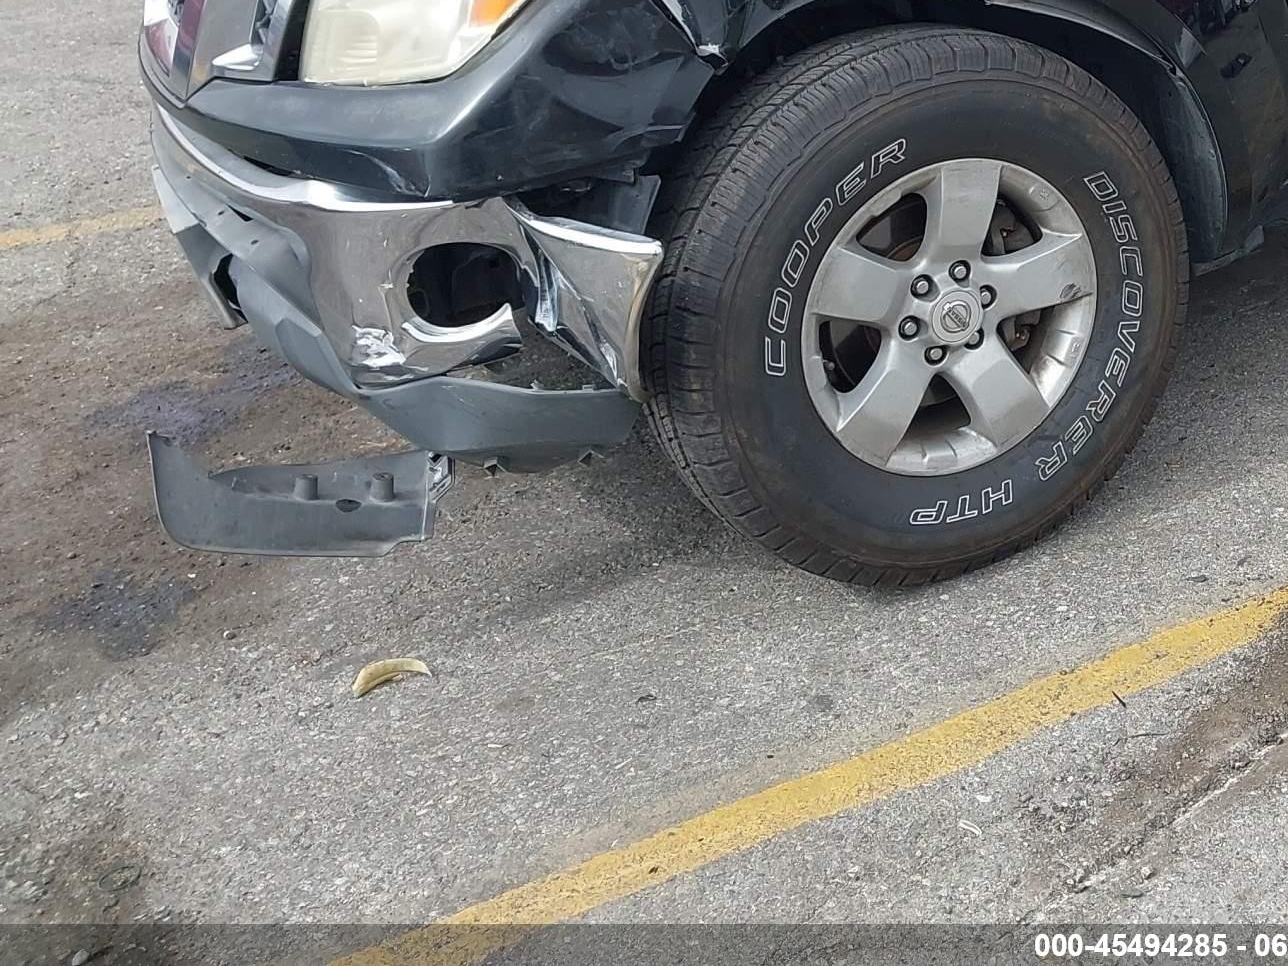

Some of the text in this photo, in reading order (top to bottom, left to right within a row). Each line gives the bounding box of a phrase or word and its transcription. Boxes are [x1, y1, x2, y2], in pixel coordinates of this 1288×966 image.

[764, 138, 906, 377] COOPER
[909, 170, 1145, 526] DISCOVERER HTP
